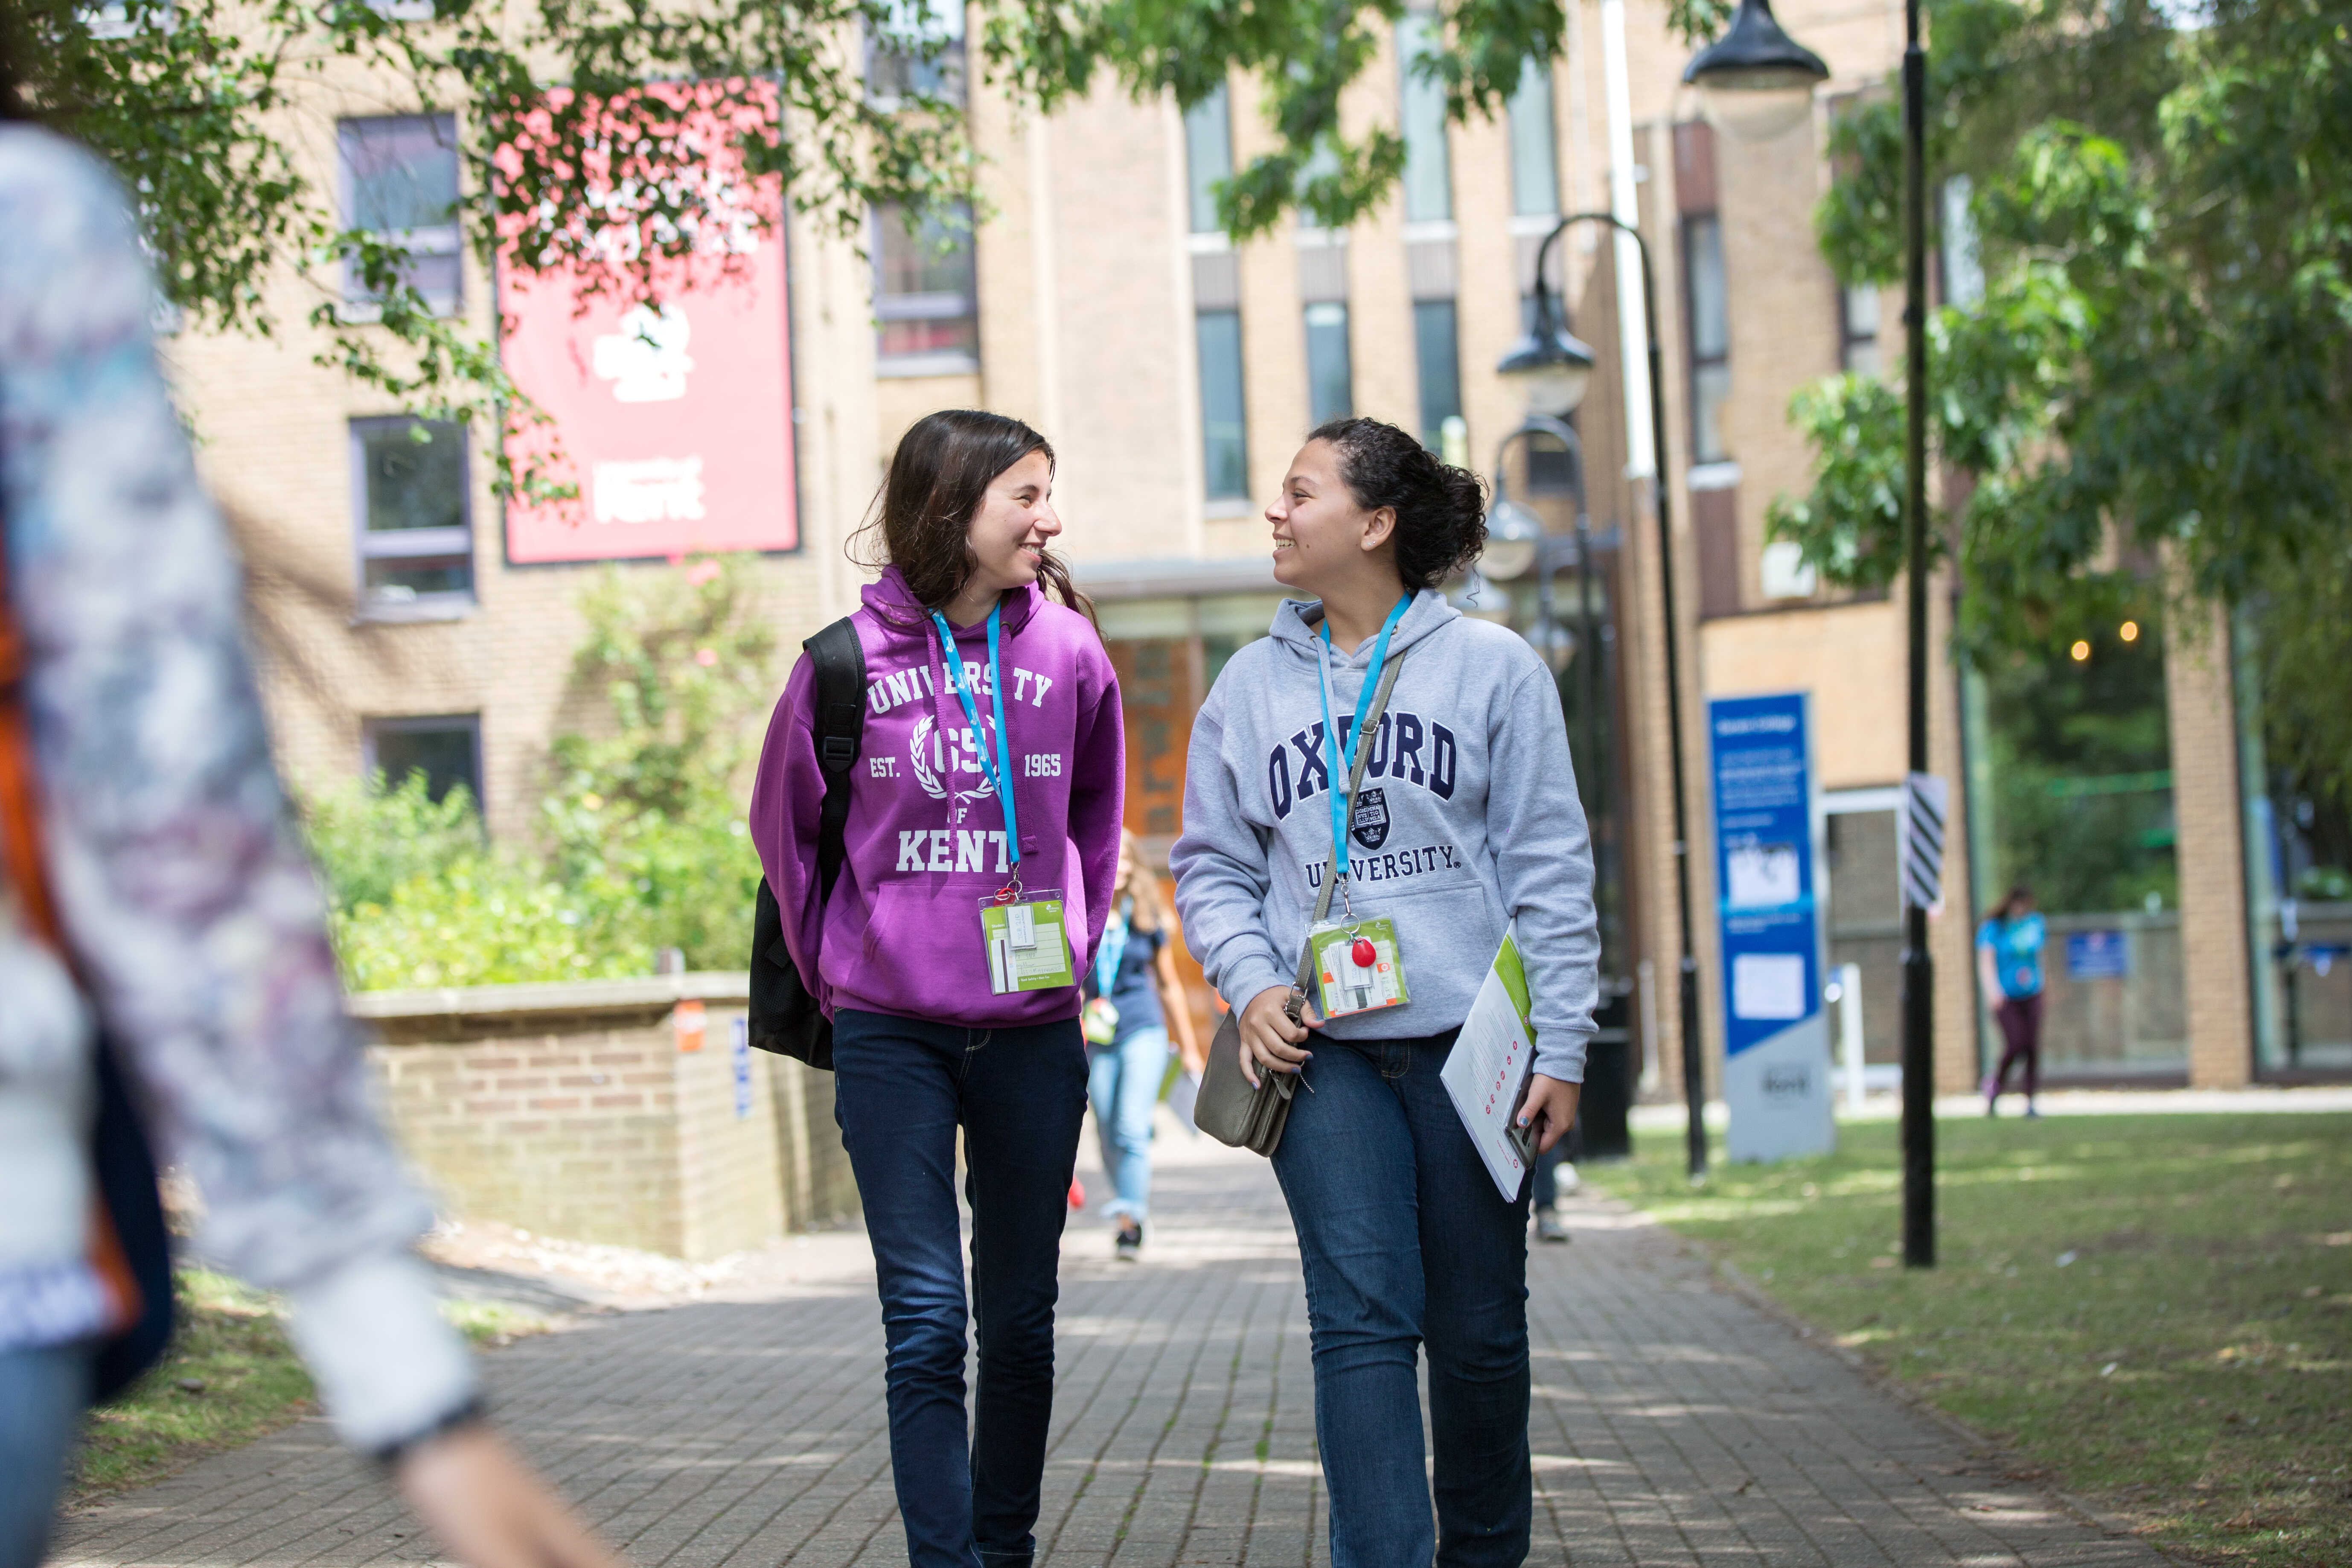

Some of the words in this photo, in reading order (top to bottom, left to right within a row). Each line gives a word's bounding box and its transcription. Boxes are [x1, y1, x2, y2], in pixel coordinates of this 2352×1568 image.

[868, 661, 1053, 714] UNIVERSTY
[870, 756, 900, 778] EST.
[1025, 753, 1061, 777] 1965
[895, 830, 1010, 873] KENT
